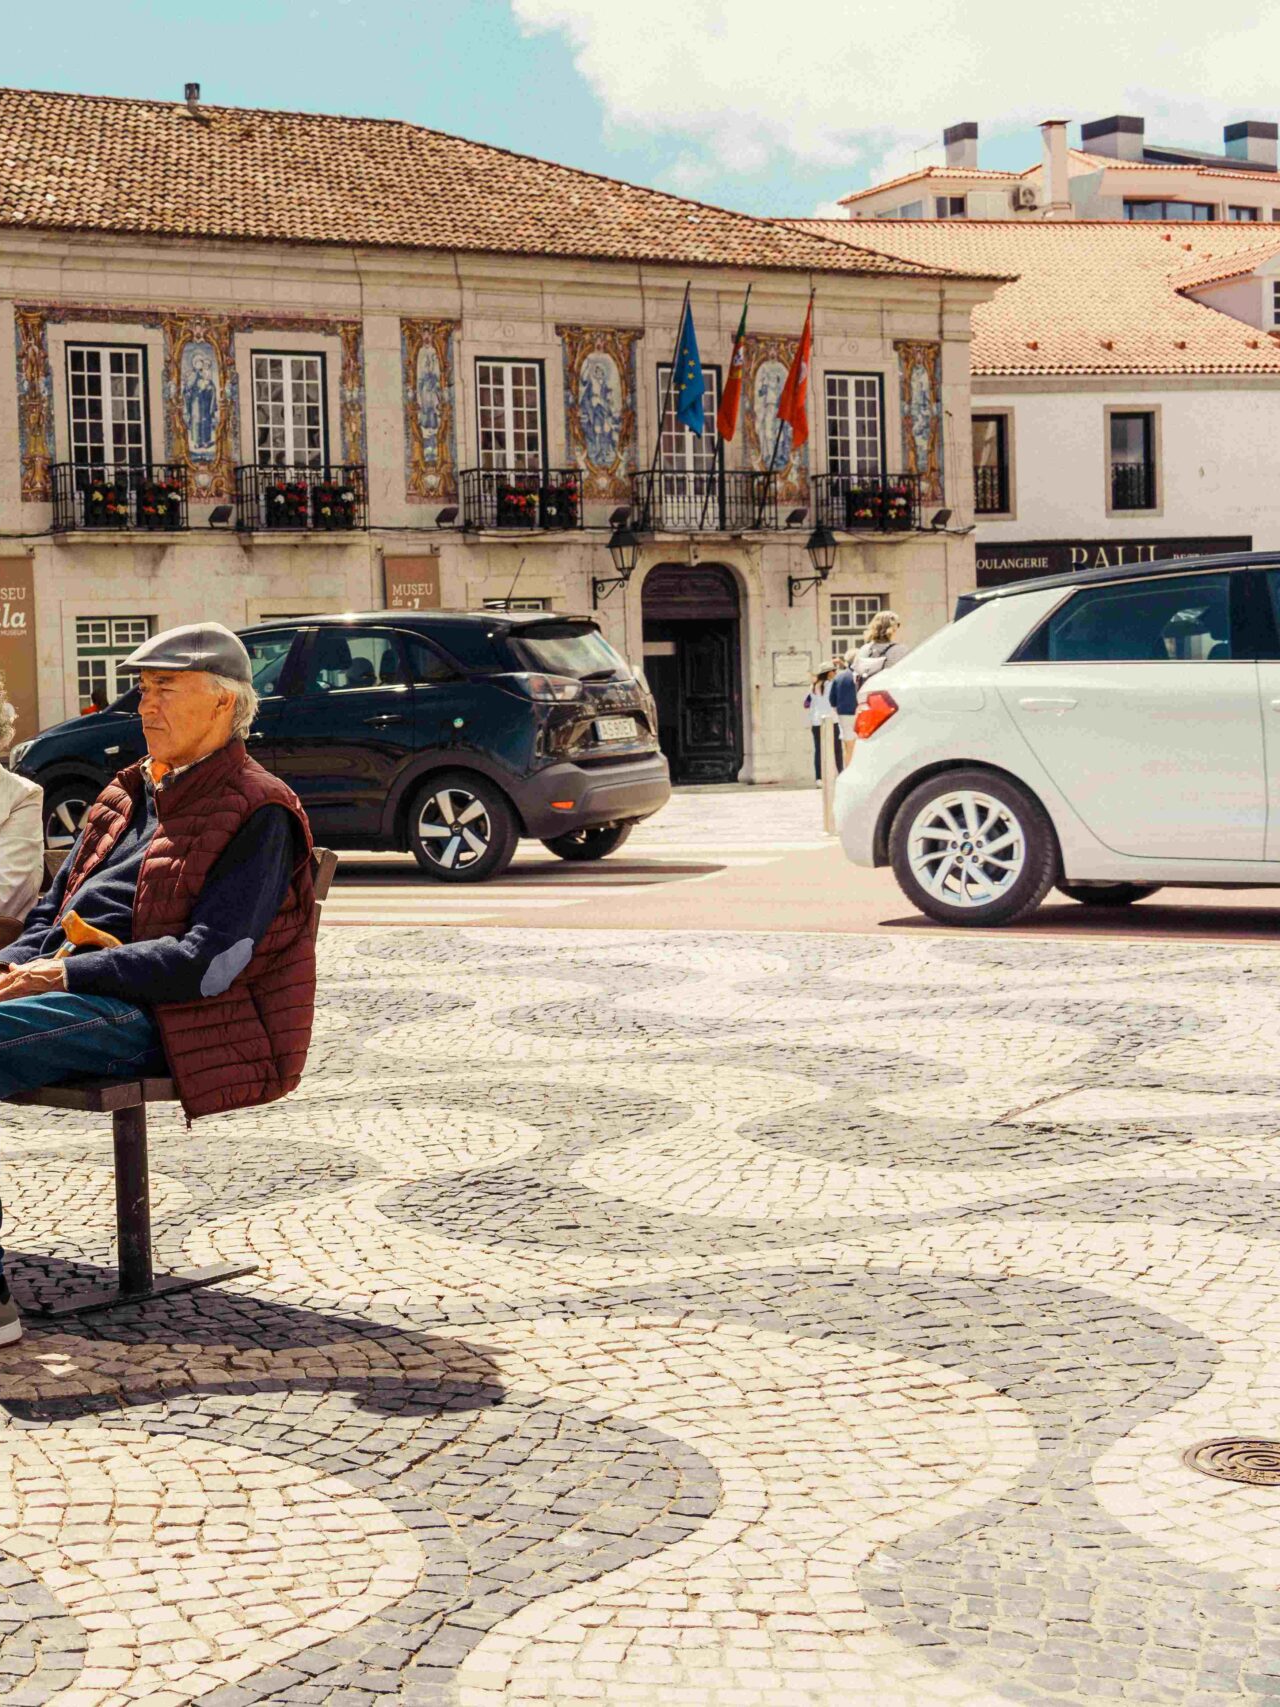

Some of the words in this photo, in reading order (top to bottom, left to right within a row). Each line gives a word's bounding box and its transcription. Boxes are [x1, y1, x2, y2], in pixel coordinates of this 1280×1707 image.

[976, 557, 1049, 570] OULANGERIE
[392, 583, 433, 596] MUSEU
[392, 596, 403, 607] da
